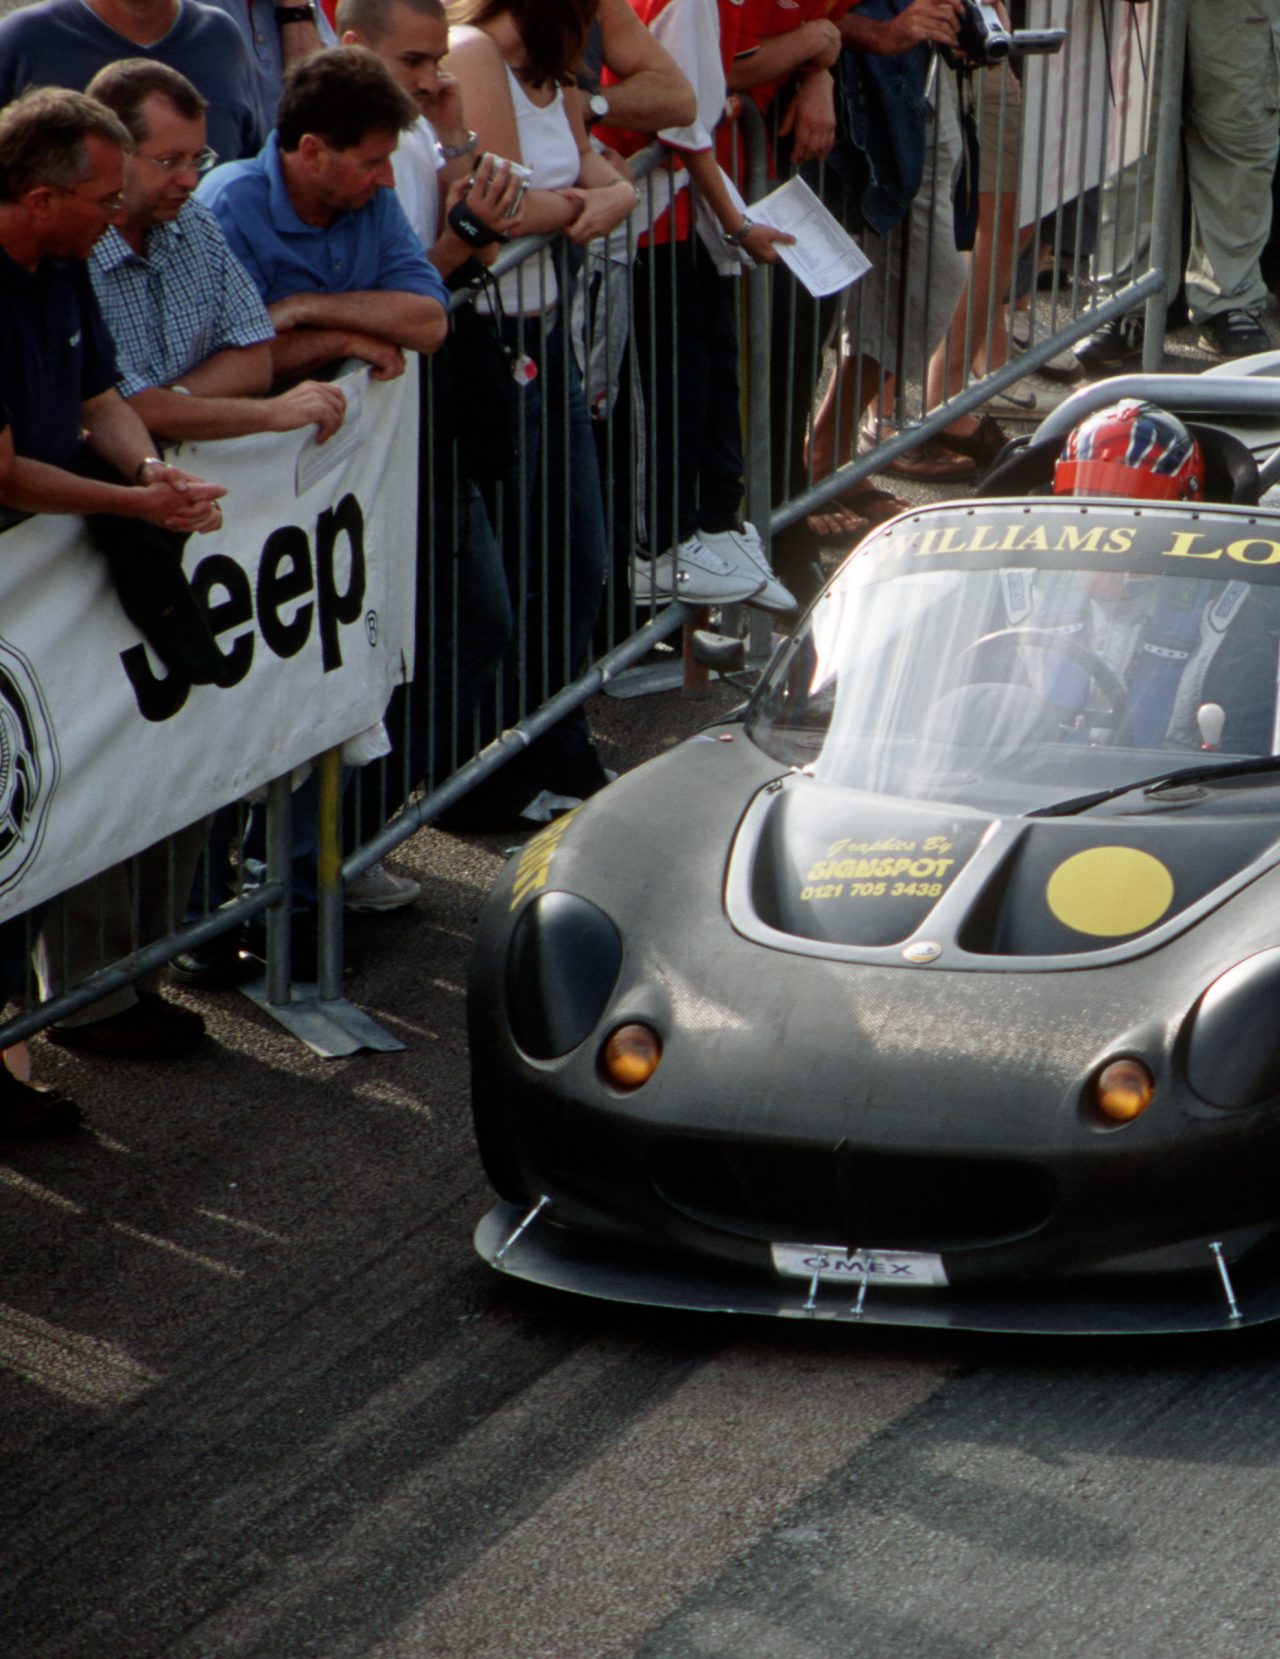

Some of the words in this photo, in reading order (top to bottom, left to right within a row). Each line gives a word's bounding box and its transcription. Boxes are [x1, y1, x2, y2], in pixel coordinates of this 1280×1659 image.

[459, 220, 479, 237] JVC
[826, 838, 917, 857] Graphics
[922, 835, 953, 855] By
[806, 857, 955, 881] SIGNSPOT
[801, 883, 845, 900] 0121
[850, 882, 887, 897] 705
[891, 882, 942, 897] 3438
[802, 1257, 914, 1275] OMEX
